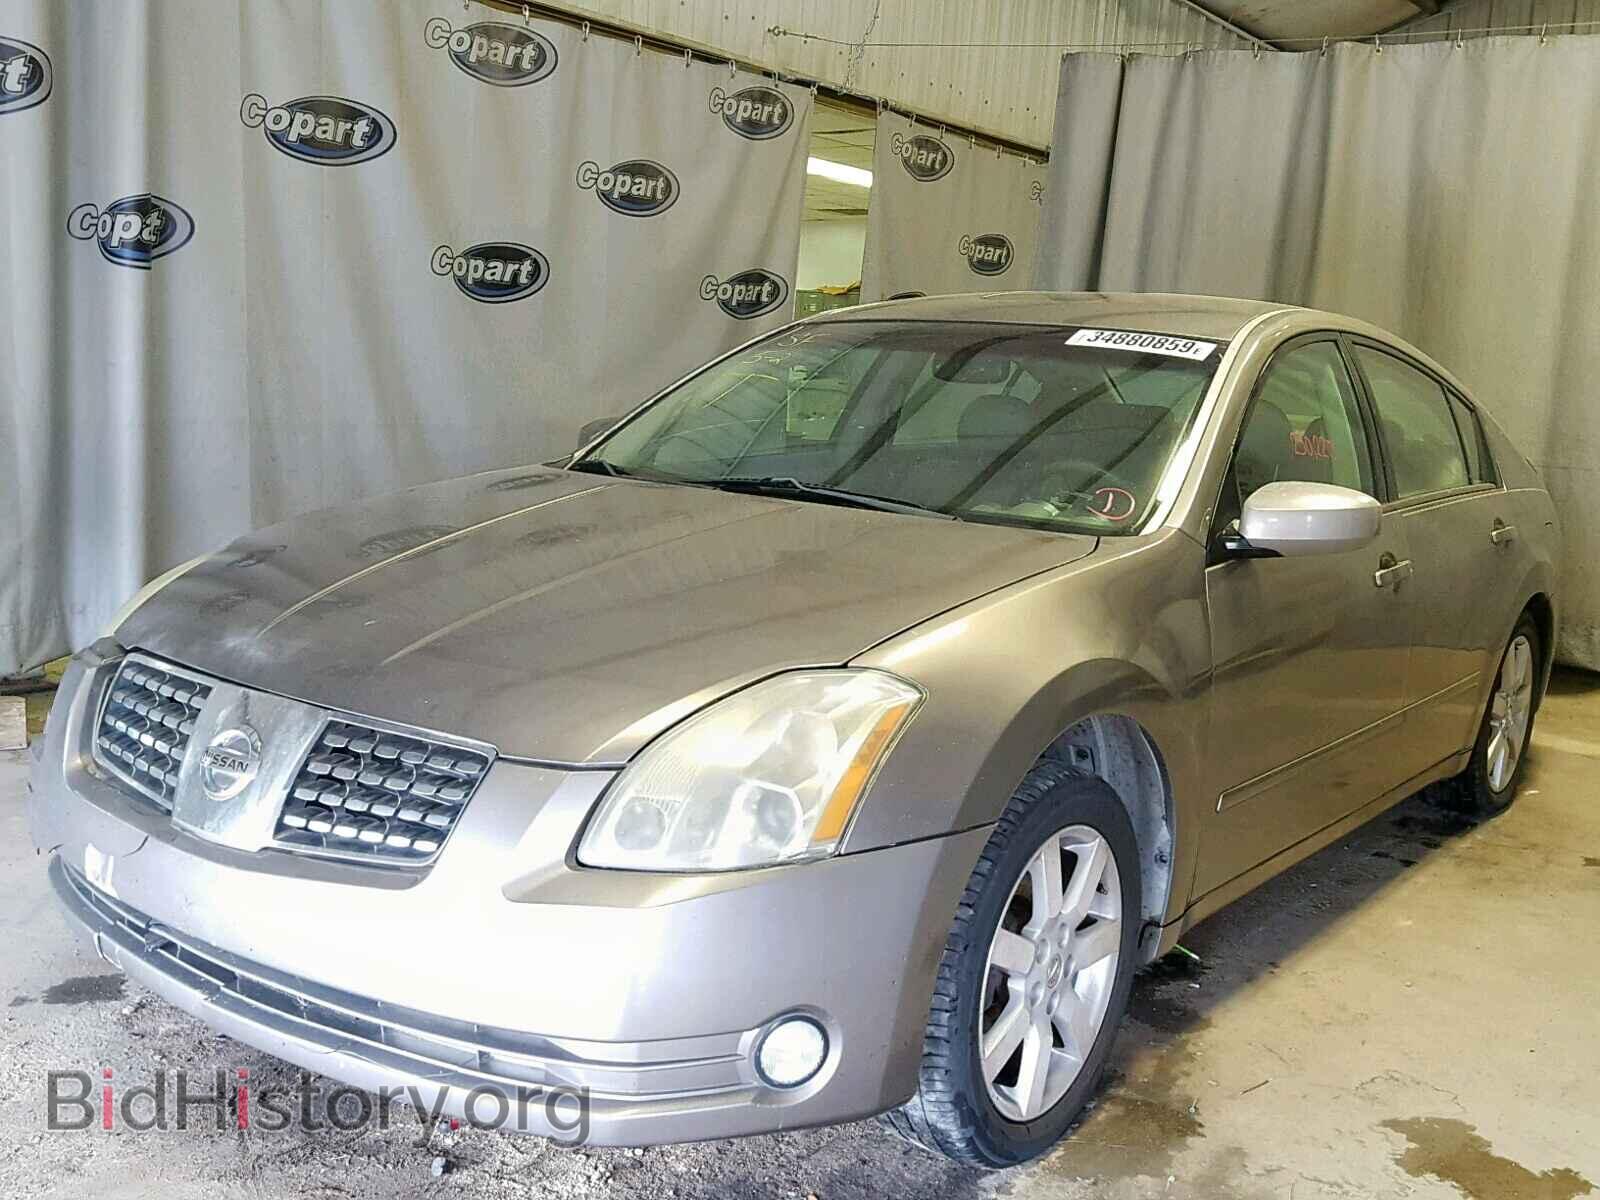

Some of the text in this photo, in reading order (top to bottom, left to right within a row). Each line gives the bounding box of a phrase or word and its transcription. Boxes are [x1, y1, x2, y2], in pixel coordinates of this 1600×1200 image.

[424, 17, 540, 72] Copart
[240, 93, 373, 149] Copart
[709, 87, 784, 125] Copart
[892, 133, 944, 170] Copart
[576, 161, 665, 201] Copart
[67, 203, 165, 249] Copat
[431, 245, 537, 287] Copart
[959, 235, 1008, 265] Copart
[700, 275, 774, 306] Copart
[202, 748, 249, 773] NISSAN
